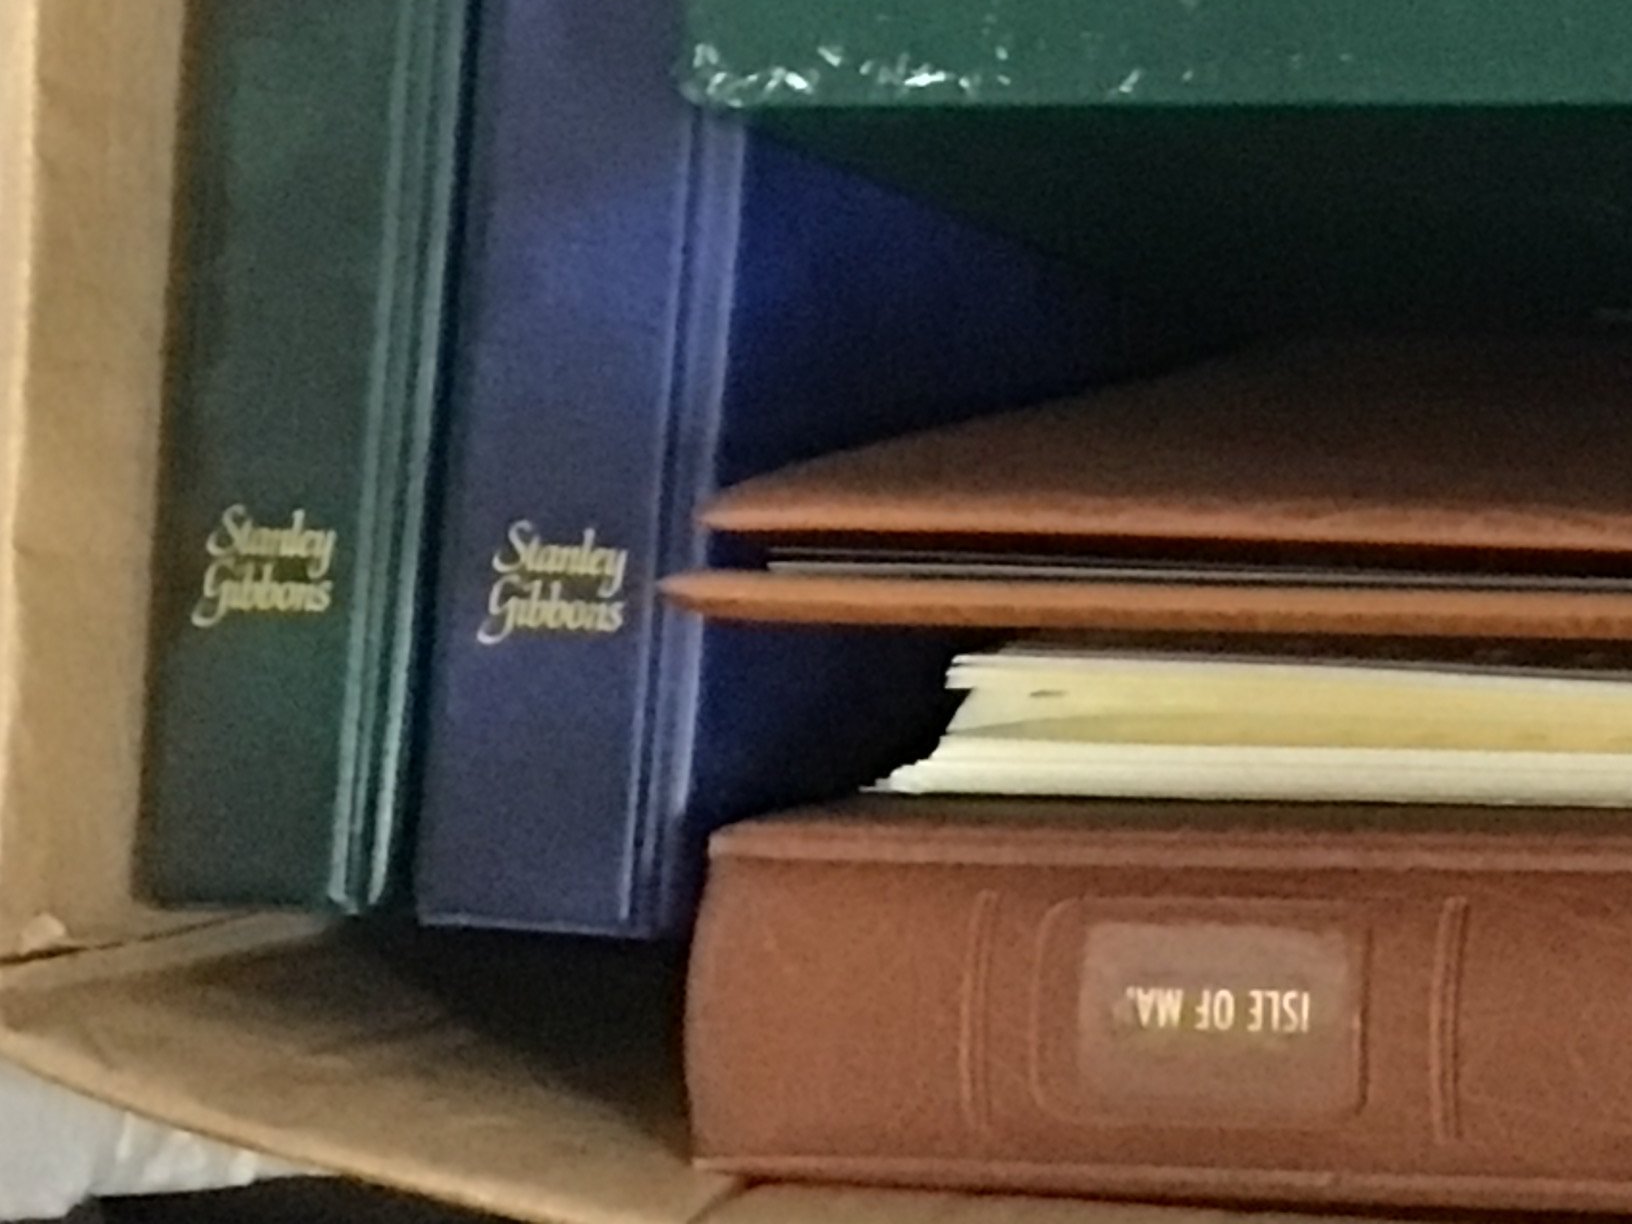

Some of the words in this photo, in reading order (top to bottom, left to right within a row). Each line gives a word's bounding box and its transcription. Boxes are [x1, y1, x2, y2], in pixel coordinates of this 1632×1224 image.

[206, 503, 337, 578] Stanley
[493, 518, 627, 598] Stanley
[191, 558, 332, 627] Gibbons
[477, 574, 623, 645] Gibbons
[1125, 985, 1185, 1028] MA
[1194, 988, 1236, 1031] OF
[1246, 989, 1311, 1033] ISLE
